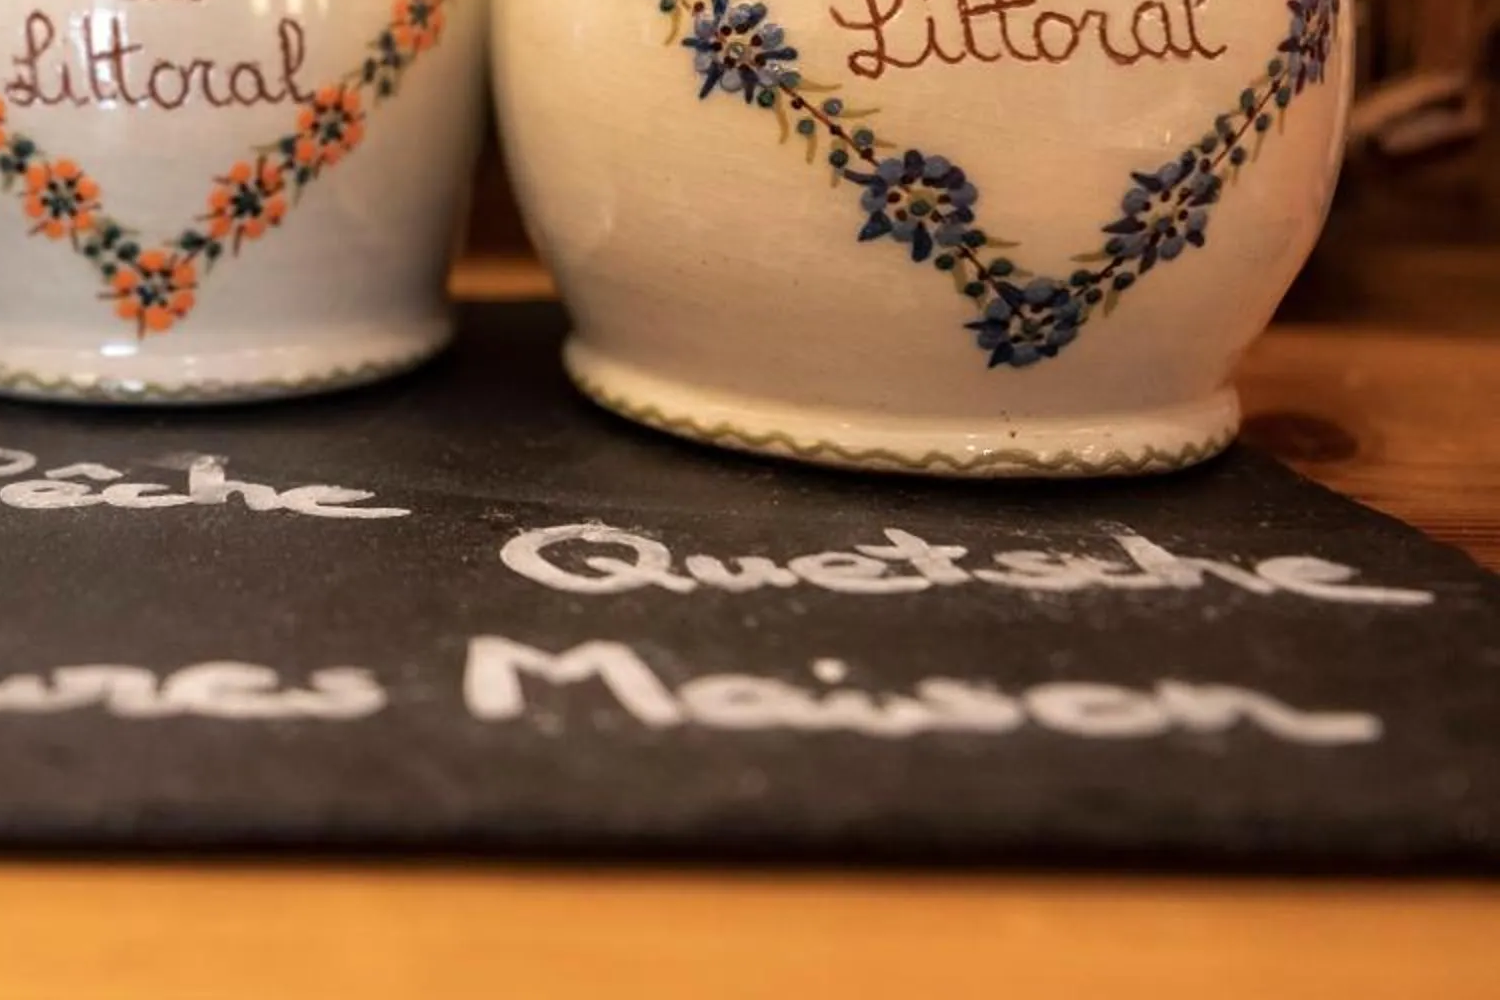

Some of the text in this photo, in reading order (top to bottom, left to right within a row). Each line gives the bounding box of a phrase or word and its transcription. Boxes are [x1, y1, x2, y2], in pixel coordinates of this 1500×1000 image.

[5, 11, 316, 111] Littoral
[500, 522, 1434, 605] Quetsche
[464, 634, 1383, 743] Maison
